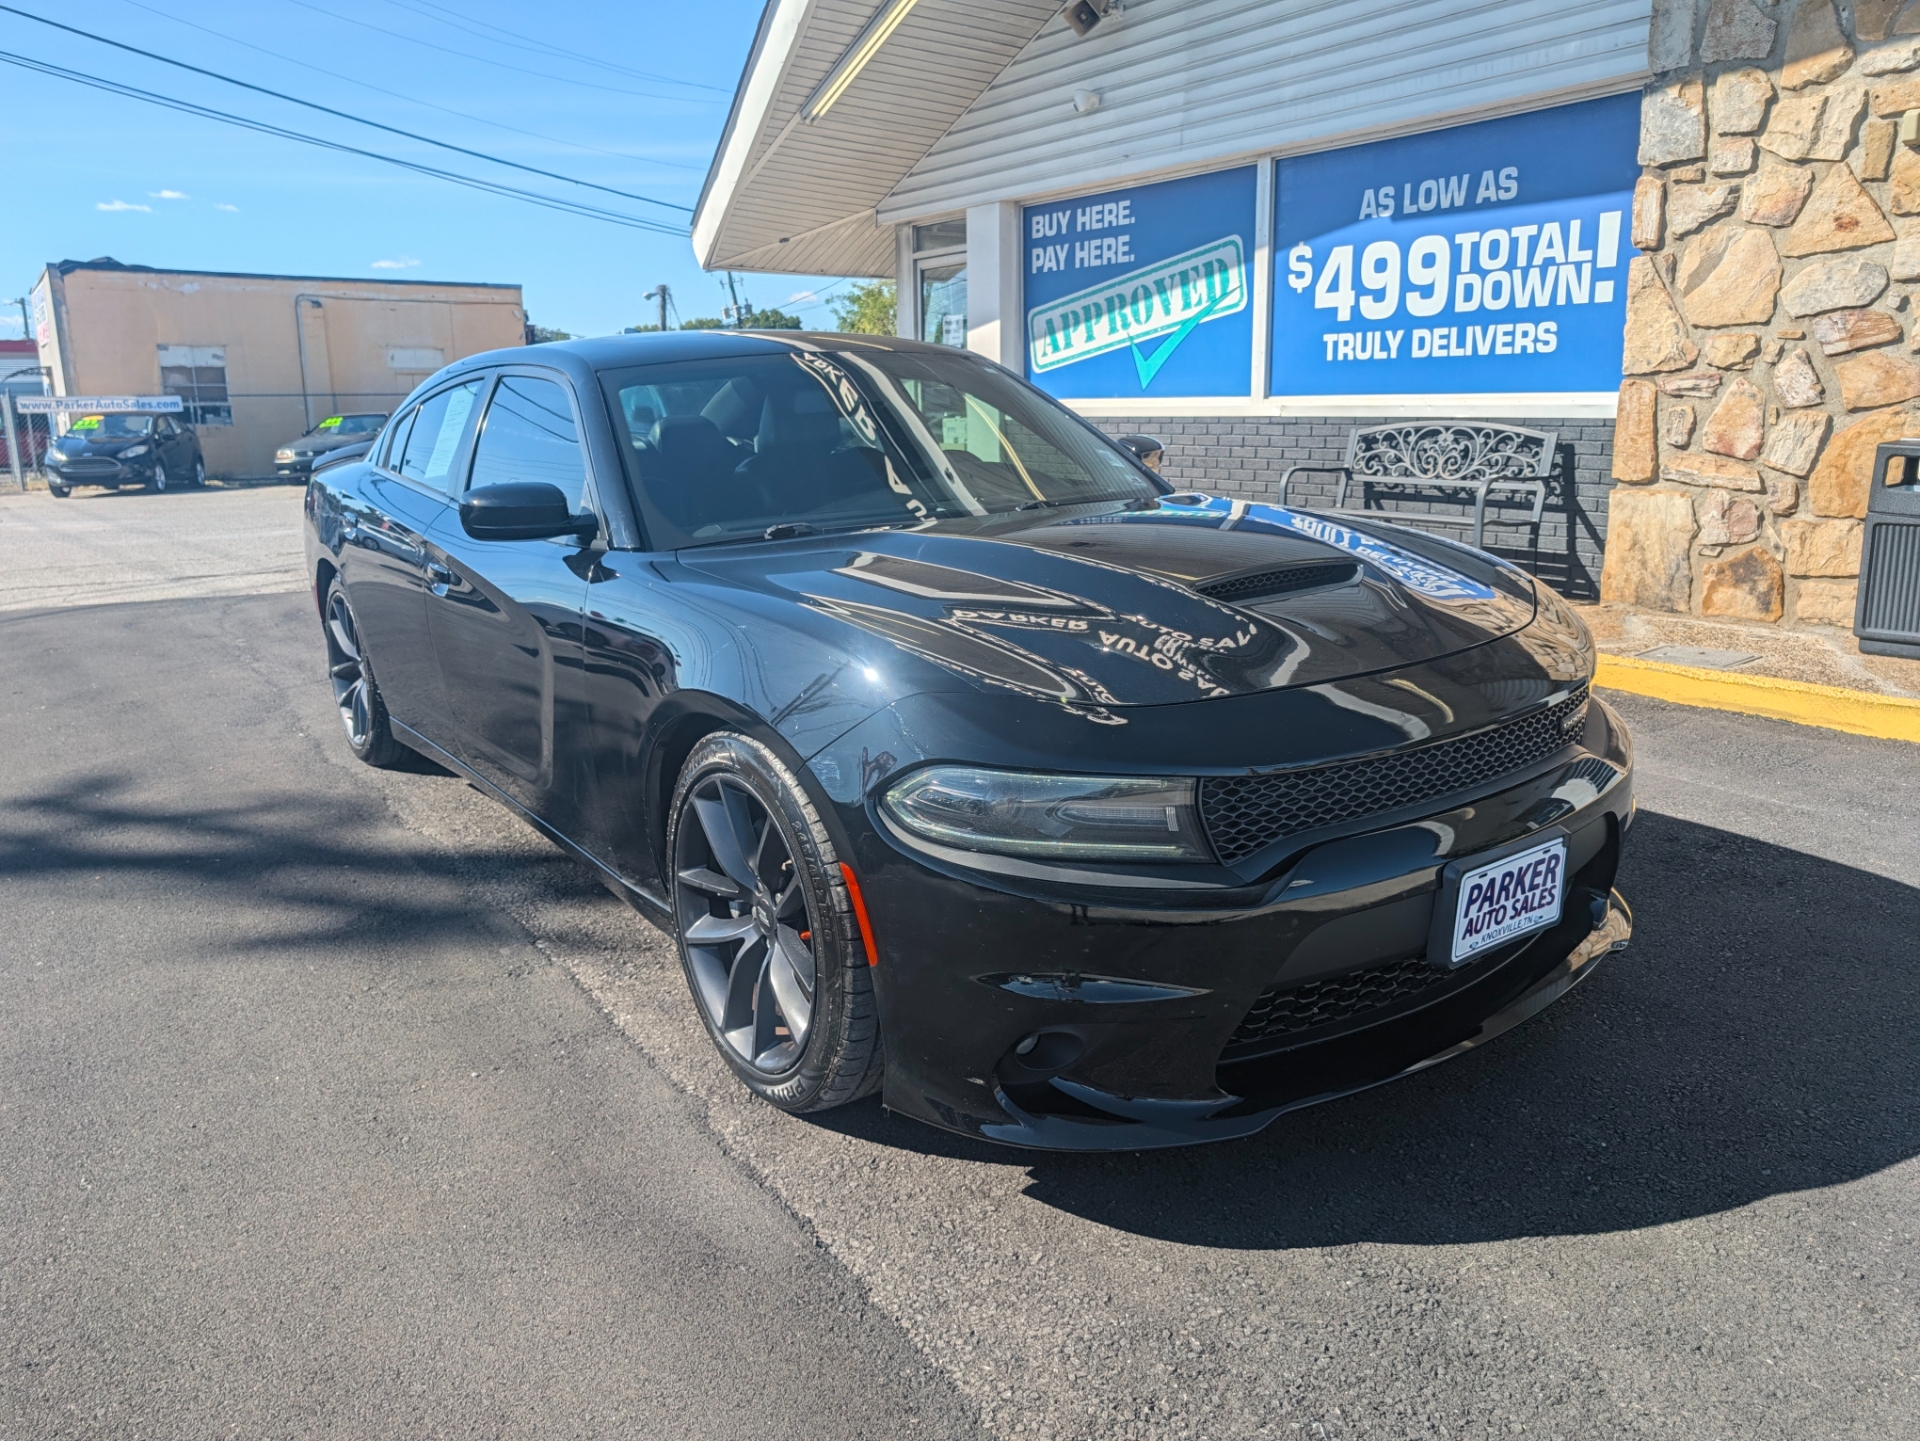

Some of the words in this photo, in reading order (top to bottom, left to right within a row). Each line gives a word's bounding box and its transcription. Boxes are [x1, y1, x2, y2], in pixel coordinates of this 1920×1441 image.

[1031, 210, 1071, 239] BUY
[1076, 200, 1136, 232] HERE.
[1358, 186, 1395, 220] AS
[1403, 174, 1470, 214] LOW
[1475, 166, 1519, 204] AS
[1031, 243, 1069, 274] PAY
[1074, 235, 1135, 268] HERE.
[1454, 219, 1593, 273] TOTAL
[1041, 258, 1230, 358] APPROVED
[1322, 329, 1405, 361] TRULY
[1411, 321, 1558, 359] DELIVERS
[19, 398, 180, 411] www.ParkerAutoSales.com
[1461, 904, 1508, 941] AUTO
[1509, 884, 1557, 920] SALES
[1463, 853, 1561, 919] PARKER
